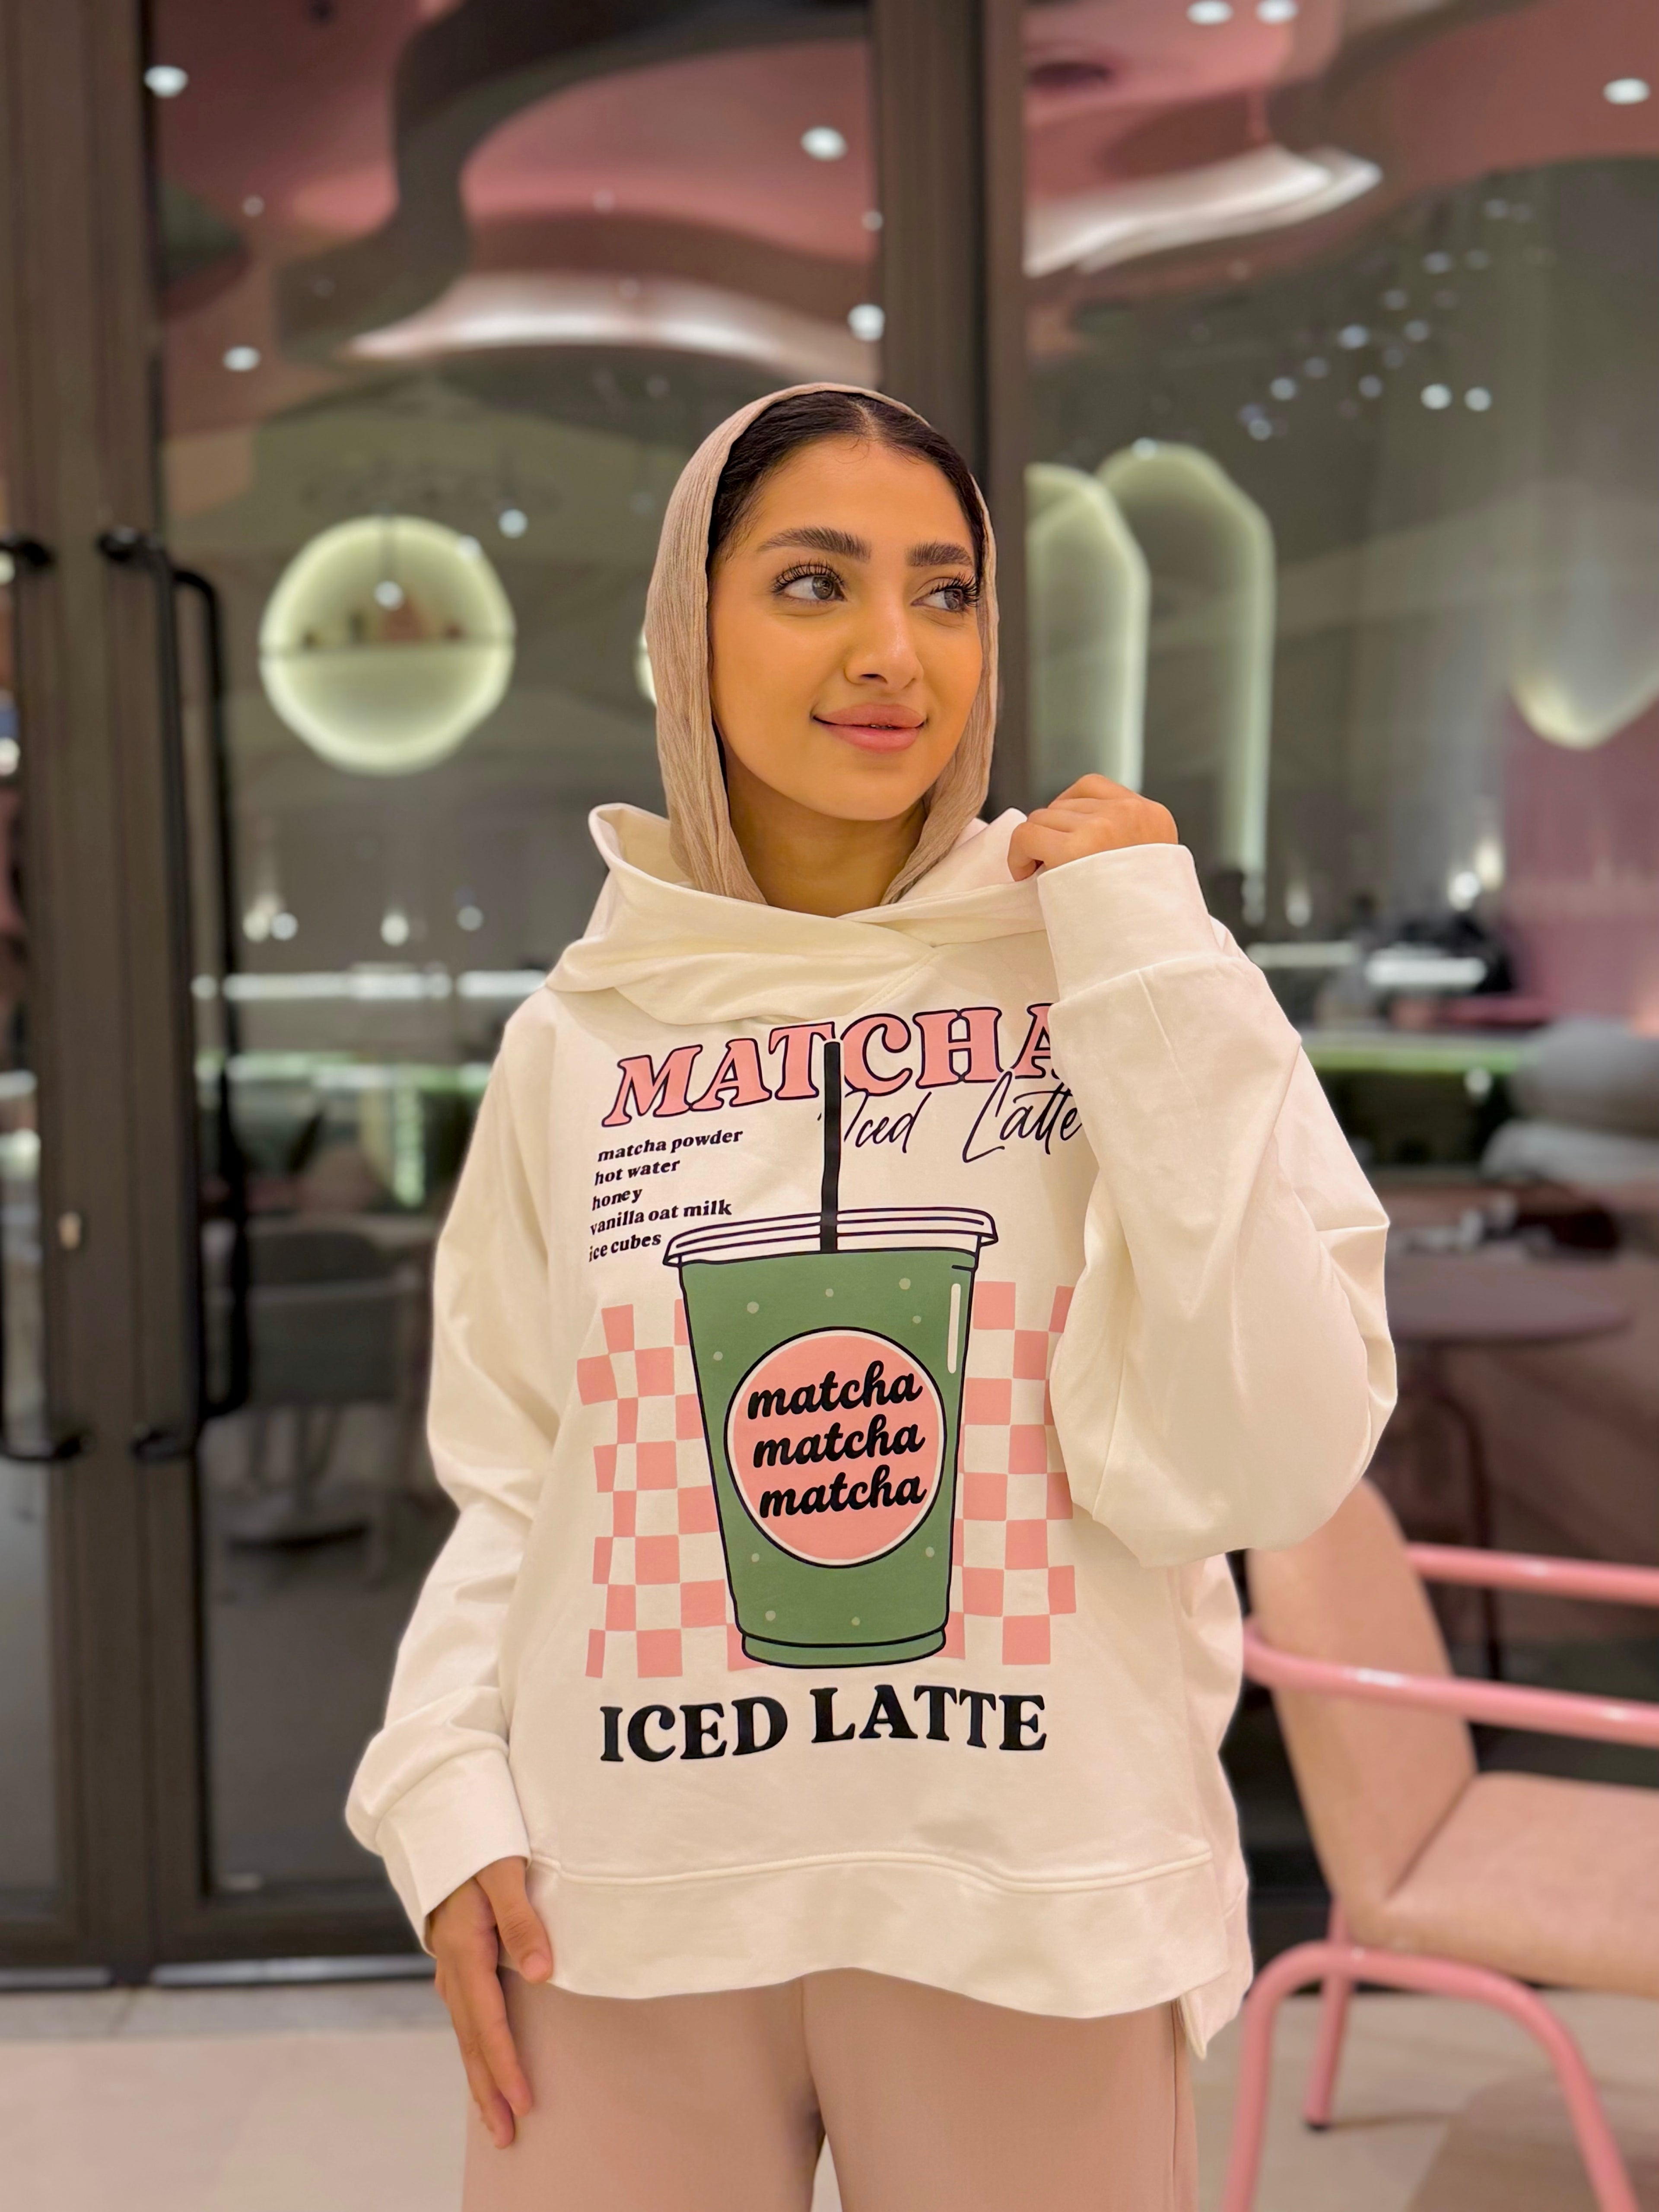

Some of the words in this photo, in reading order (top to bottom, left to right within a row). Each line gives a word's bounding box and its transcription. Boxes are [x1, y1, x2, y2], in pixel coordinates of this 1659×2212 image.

[817, 1087, 932, 1154] Iced
[962, 1070, 1082, 1163] Latte
[597, 1139, 667, 1162] matcha
[670, 1129, 744, 1154] powder
[594, 1168, 623, 1186] hot
[628, 1160, 681, 1179] water
[590, 1210, 645, 1235] vanilla
[648, 1205, 679, 1221] oat
[683, 1199, 732, 1217] milk
[591, 1189, 643, 1211] honey
[589, 1245, 608, 1262] ice
[610, 1234, 661, 1254] cubes
[747, 1360, 923, 1420] matcha
[753, 1414, 926, 1468] matcha
[759, 1464, 927, 1518] matcha
[599, 1696, 788, 1763] ICED
[809, 1684, 1048, 1751] LATTE
